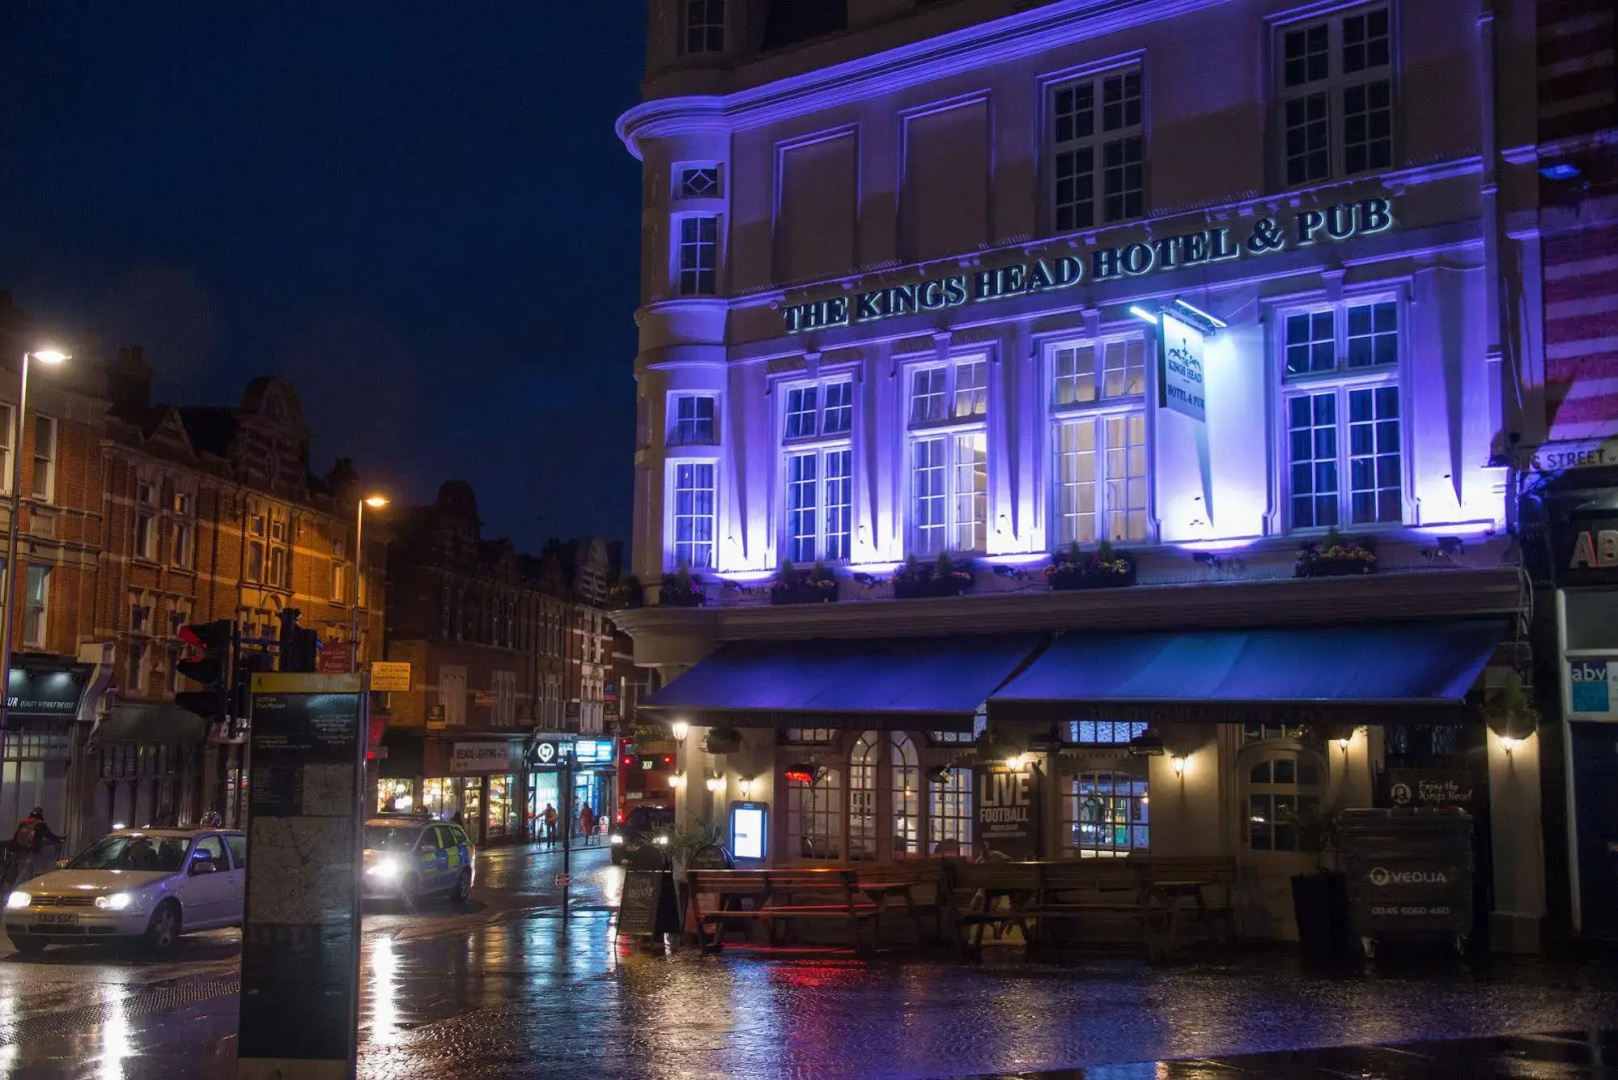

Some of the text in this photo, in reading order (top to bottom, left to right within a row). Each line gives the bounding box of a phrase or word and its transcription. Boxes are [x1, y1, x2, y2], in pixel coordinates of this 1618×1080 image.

[783, 196, 1393, 335] THE KINGS HEAD HOTEL & PUB
[1168, 359, 1202, 384] KINGS HEAD
[1167, 383, 1188, 403] HOTEL
[1193, 395, 1205, 410] PUB
[1547, 448, 1605, 469] STREET
[1572, 663, 1606, 681] abv
[642, 760, 653, 770] 207
[980, 773, 1030, 807] LIVE
[1418, 779, 1459, 792] Enjoy the
[1418, 788, 1473, 803] Kings Head
[980, 807, 1030, 823] FOOTBALL
[1391, 871, 1448, 883] VEOLIA
[1372, 906, 1398, 915] 0345
